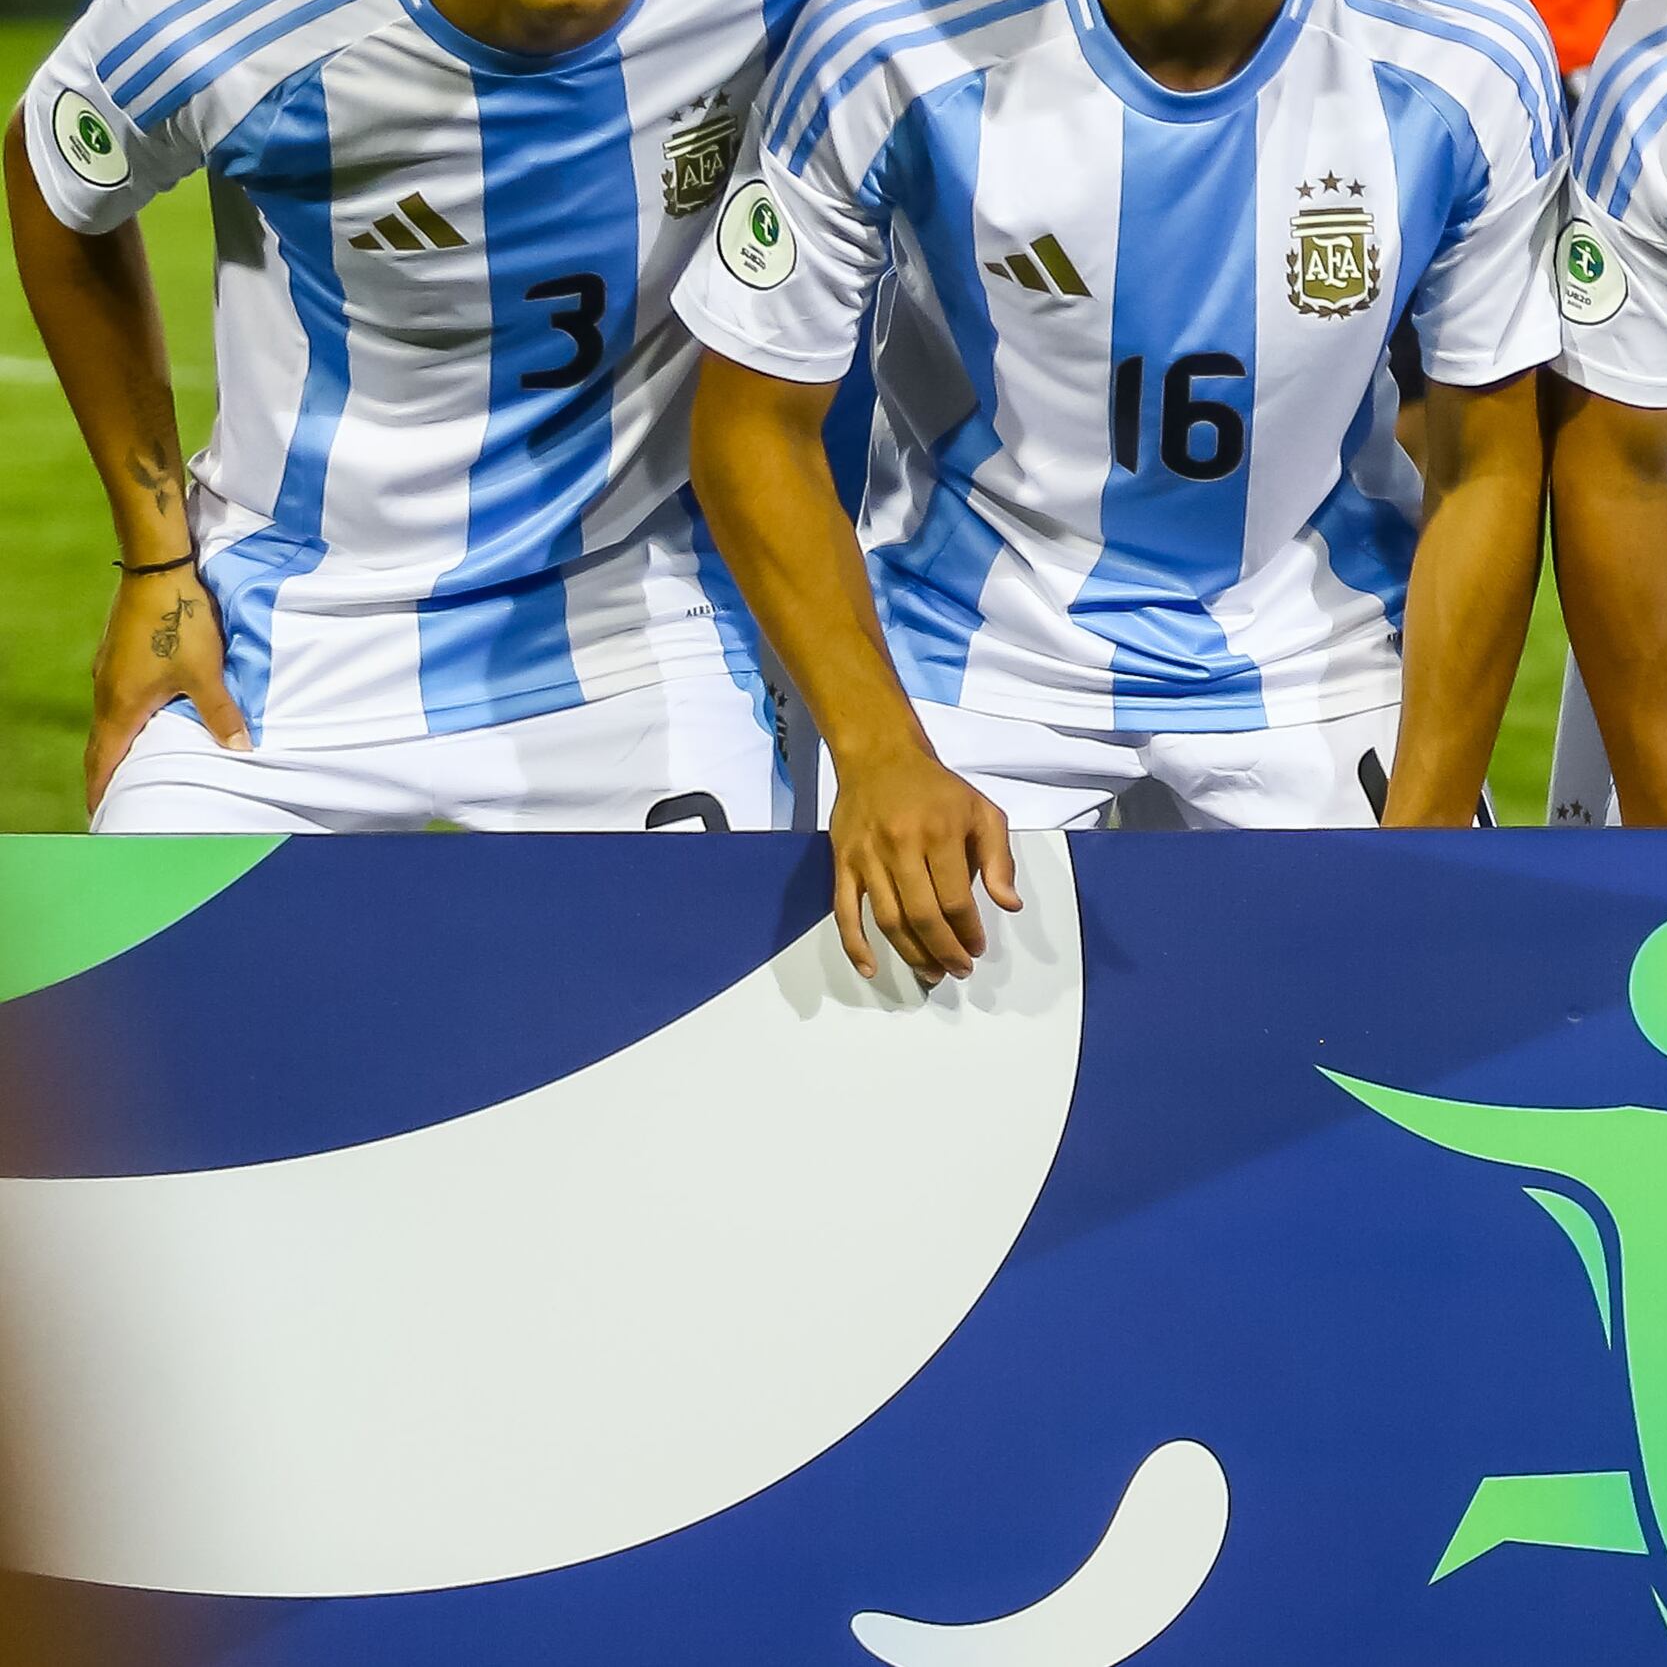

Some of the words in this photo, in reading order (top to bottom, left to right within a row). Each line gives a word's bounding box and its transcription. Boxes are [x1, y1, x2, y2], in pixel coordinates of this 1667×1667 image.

[681, 144, 726, 191] AFA
[1305, 235, 1363, 288] AFA
[521, 272, 608, 391] 3
[1112, 352, 1247, 481] 16
